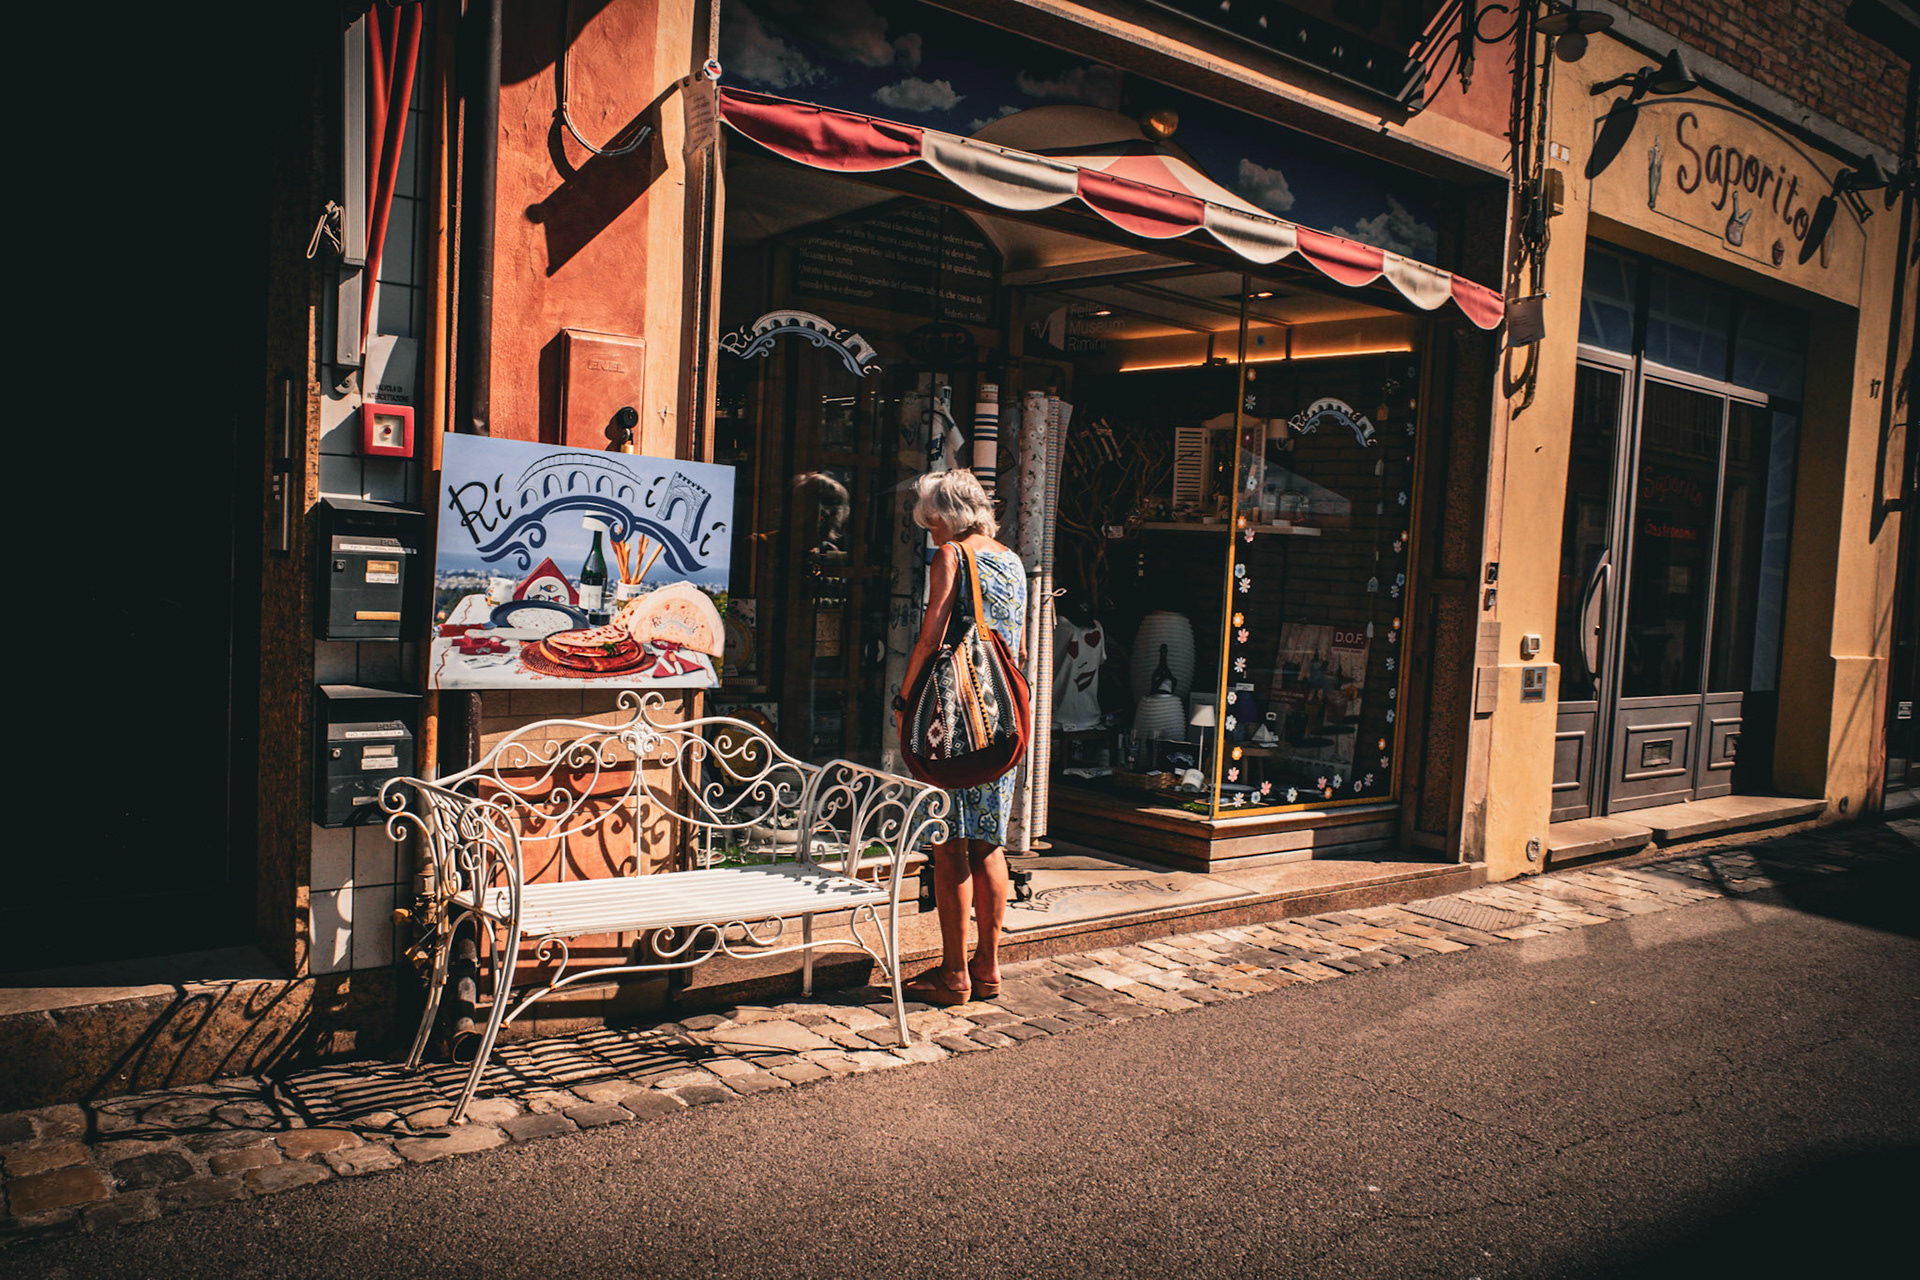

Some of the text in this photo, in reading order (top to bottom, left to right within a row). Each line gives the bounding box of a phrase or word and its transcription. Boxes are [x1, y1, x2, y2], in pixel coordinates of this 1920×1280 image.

[1677, 112, 1809, 241] Saporito
[1068, 319, 1125, 335] Museum
[1068, 336, 1107, 352] Rimini
[588, 359, 625, 373] ENEL
[1870, 378, 1882, 399] 17
[1334, 631, 1365, 645] D.O.F.
